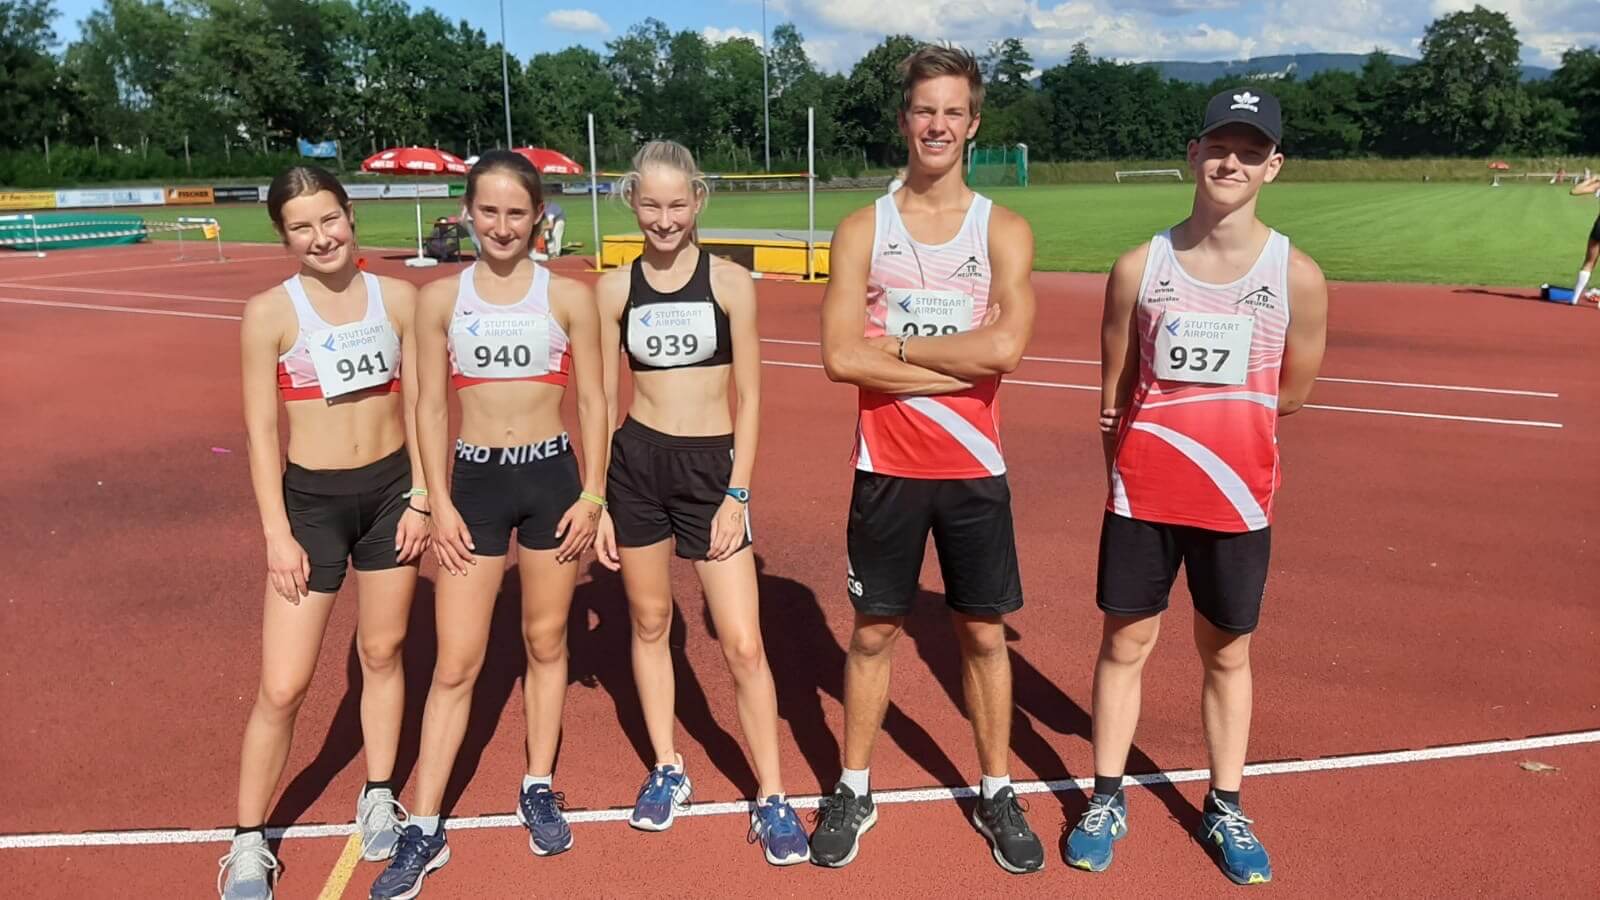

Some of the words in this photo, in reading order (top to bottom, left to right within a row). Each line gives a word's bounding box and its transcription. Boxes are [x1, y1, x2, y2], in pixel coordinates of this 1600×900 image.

[915, 297, 966, 307] STUTTGART
[1256, 294, 1269, 303] TB
[1244, 299, 1275, 310] NEUFFEN
[655, 309, 702, 319] STUTTGART
[914, 306, 954, 316] AIRPORT
[484, 319, 536, 329] STUTTGART
[655, 318, 691, 327] AIRPORT
[1183, 320, 1240, 331] STUTTGART
[337, 324, 385, 342] STUTTGART
[484, 327, 524, 337] AIRPORT
[1183, 329, 1226, 340] AIRPORT
[340, 335, 377, 350] AIRPORT
[646, 333, 698, 358] 939
[473, 344, 532, 369] 940
[1169, 346, 1231, 373] 937
[336, 350, 390, 383] 941
[456, 439, 491, 463] PRO
[499, 436, 560, 466] NIKE
